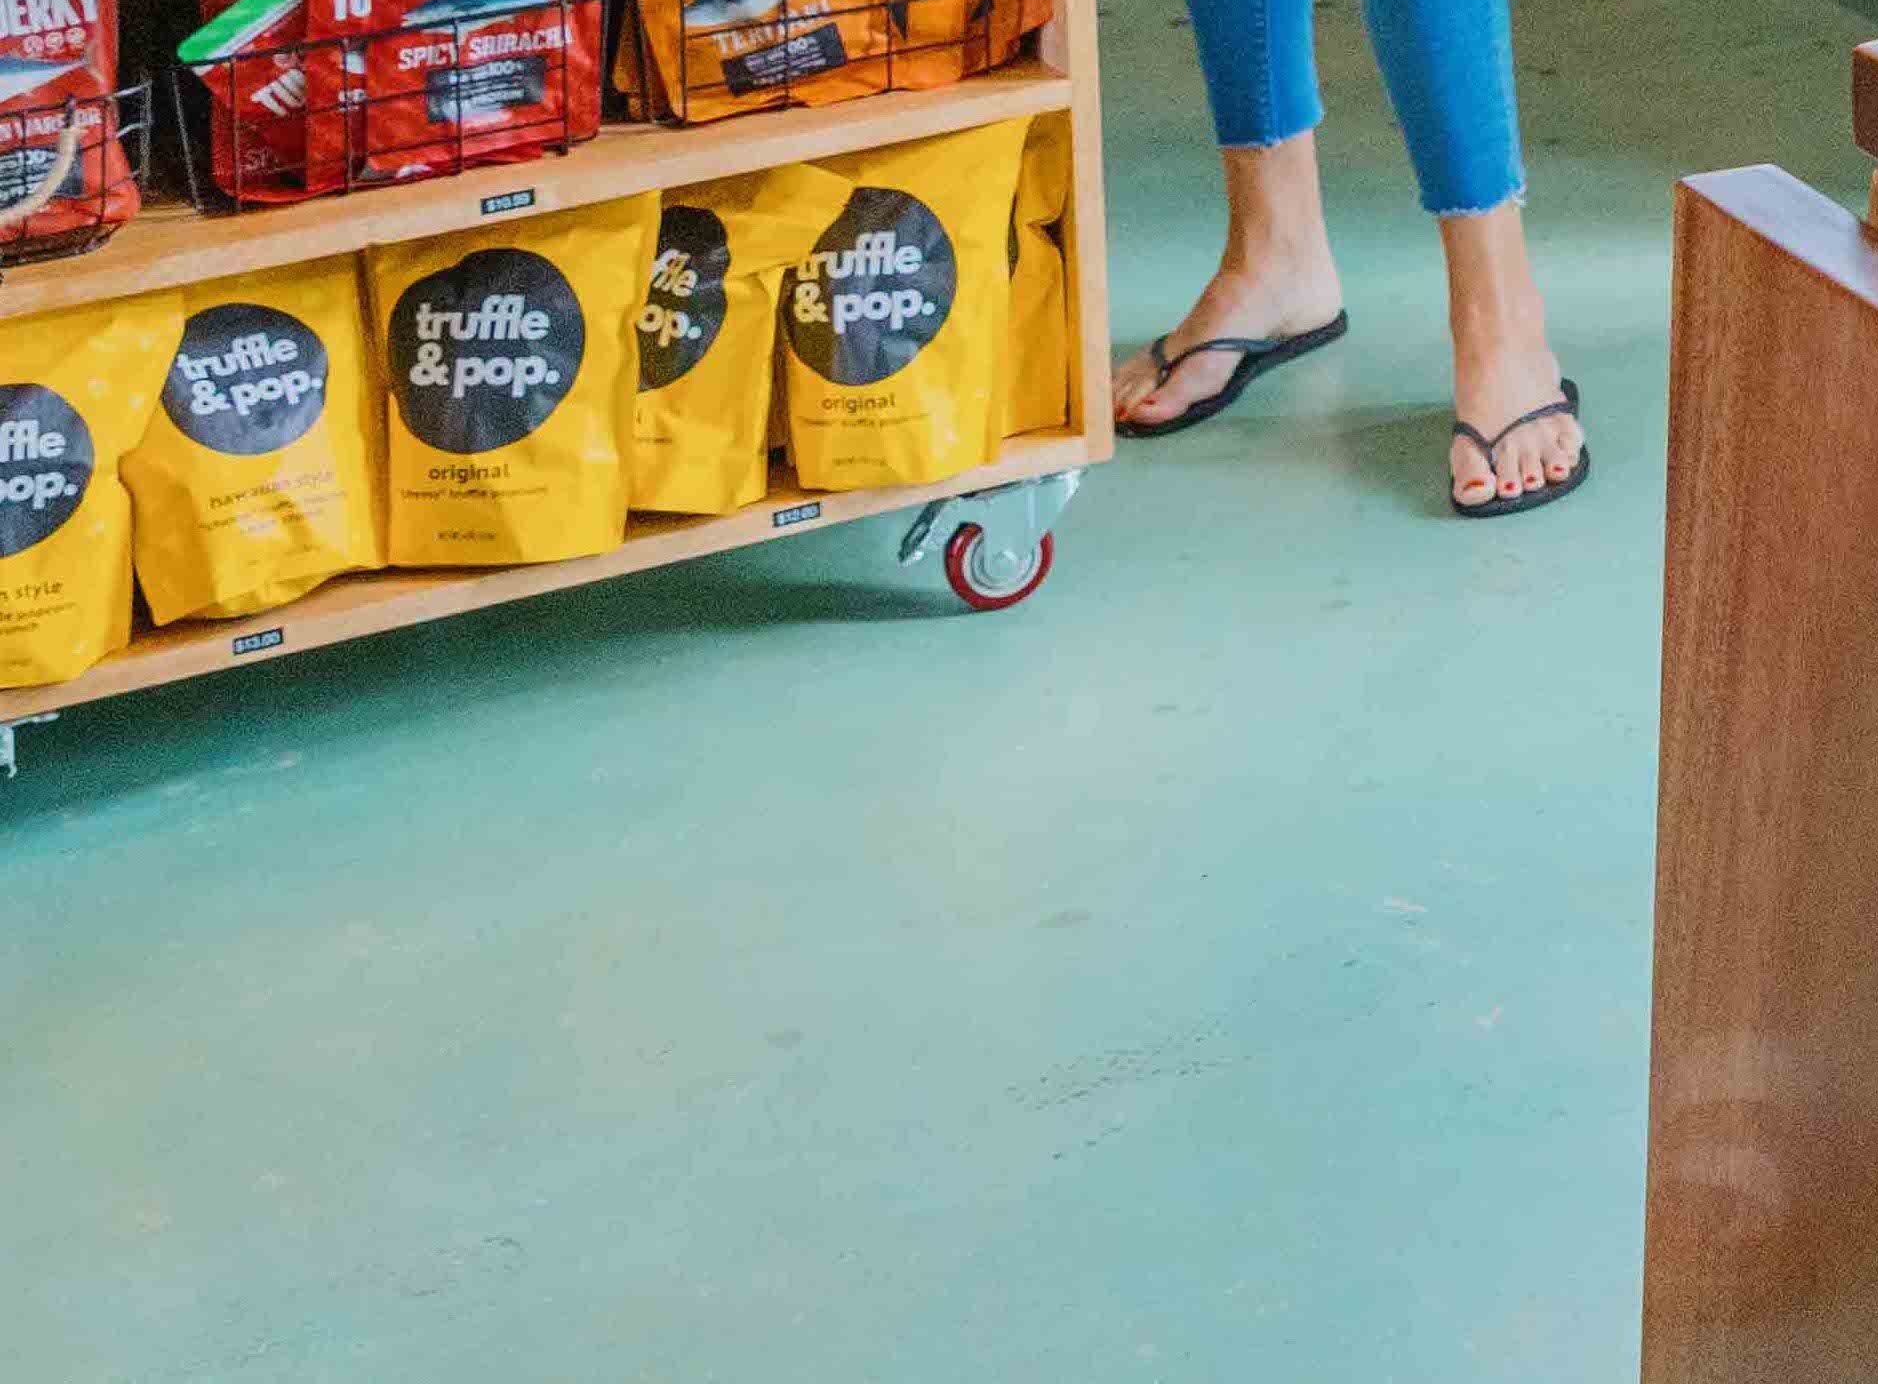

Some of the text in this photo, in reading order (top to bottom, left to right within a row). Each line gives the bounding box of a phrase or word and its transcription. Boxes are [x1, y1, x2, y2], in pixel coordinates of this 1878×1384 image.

[416, 294, 551, 340] truffle
[636, 303, 702, 349] op.
[794, 282, 936, 335] & pop.
[177, 331, 300, 381] truffle
[409, 342, 561, 400] & pop.
[190, 369, 324, 416] & pop.
[821, 392, 897, 414] original
[428, 463, 511, 484] original
